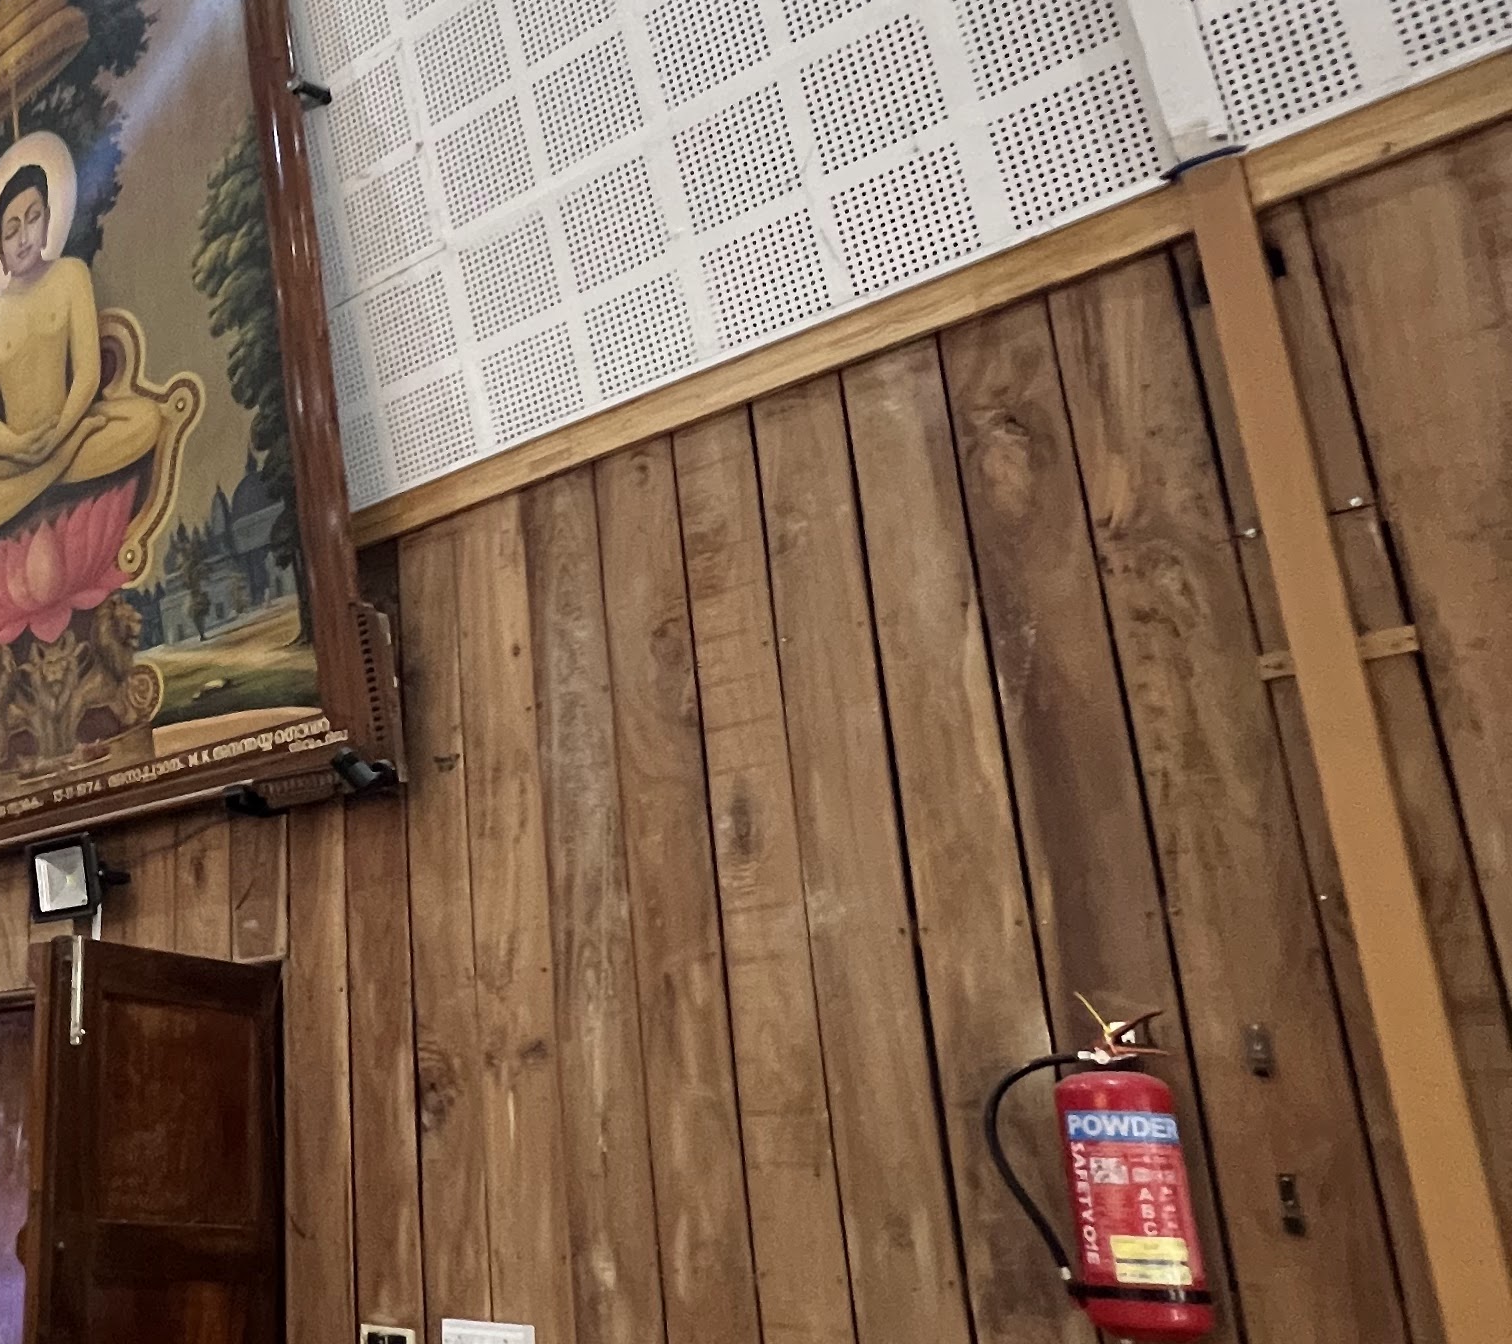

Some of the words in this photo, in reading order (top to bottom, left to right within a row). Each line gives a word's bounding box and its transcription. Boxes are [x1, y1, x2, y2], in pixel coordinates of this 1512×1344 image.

[1067, 1114, 1179, 1139] POWDER
[1139, 1188, 1154, 1202] A
[1141, 1203, 1156, 1219] B
[1143, 1221, 1158, 1235] C
